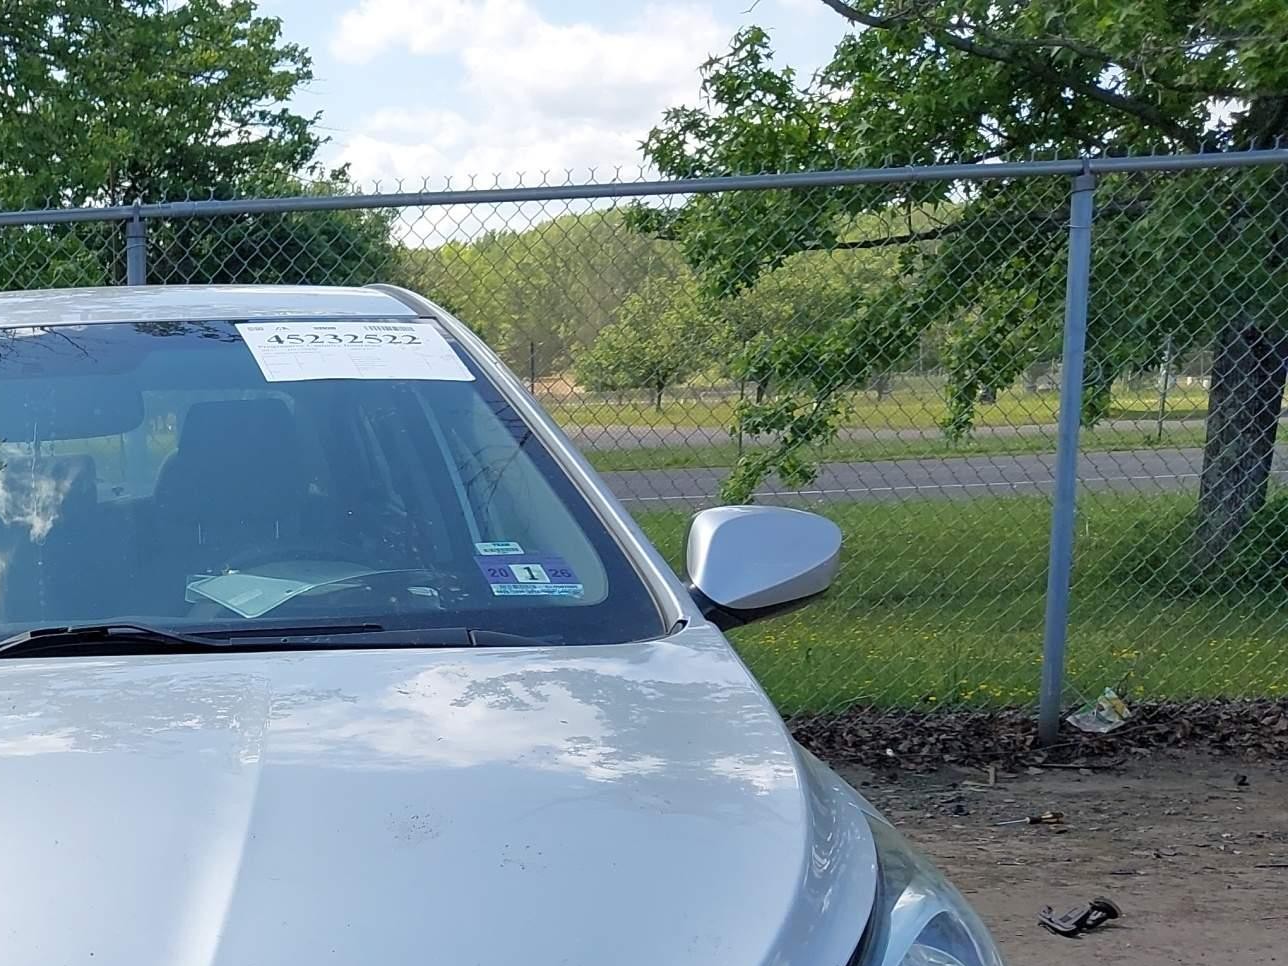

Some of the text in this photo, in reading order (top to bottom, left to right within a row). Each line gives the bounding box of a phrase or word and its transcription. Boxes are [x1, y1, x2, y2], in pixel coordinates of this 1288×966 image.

[267, 333, 423, 345] 45232522
[487, 566, 572, 581] 20 1 26
